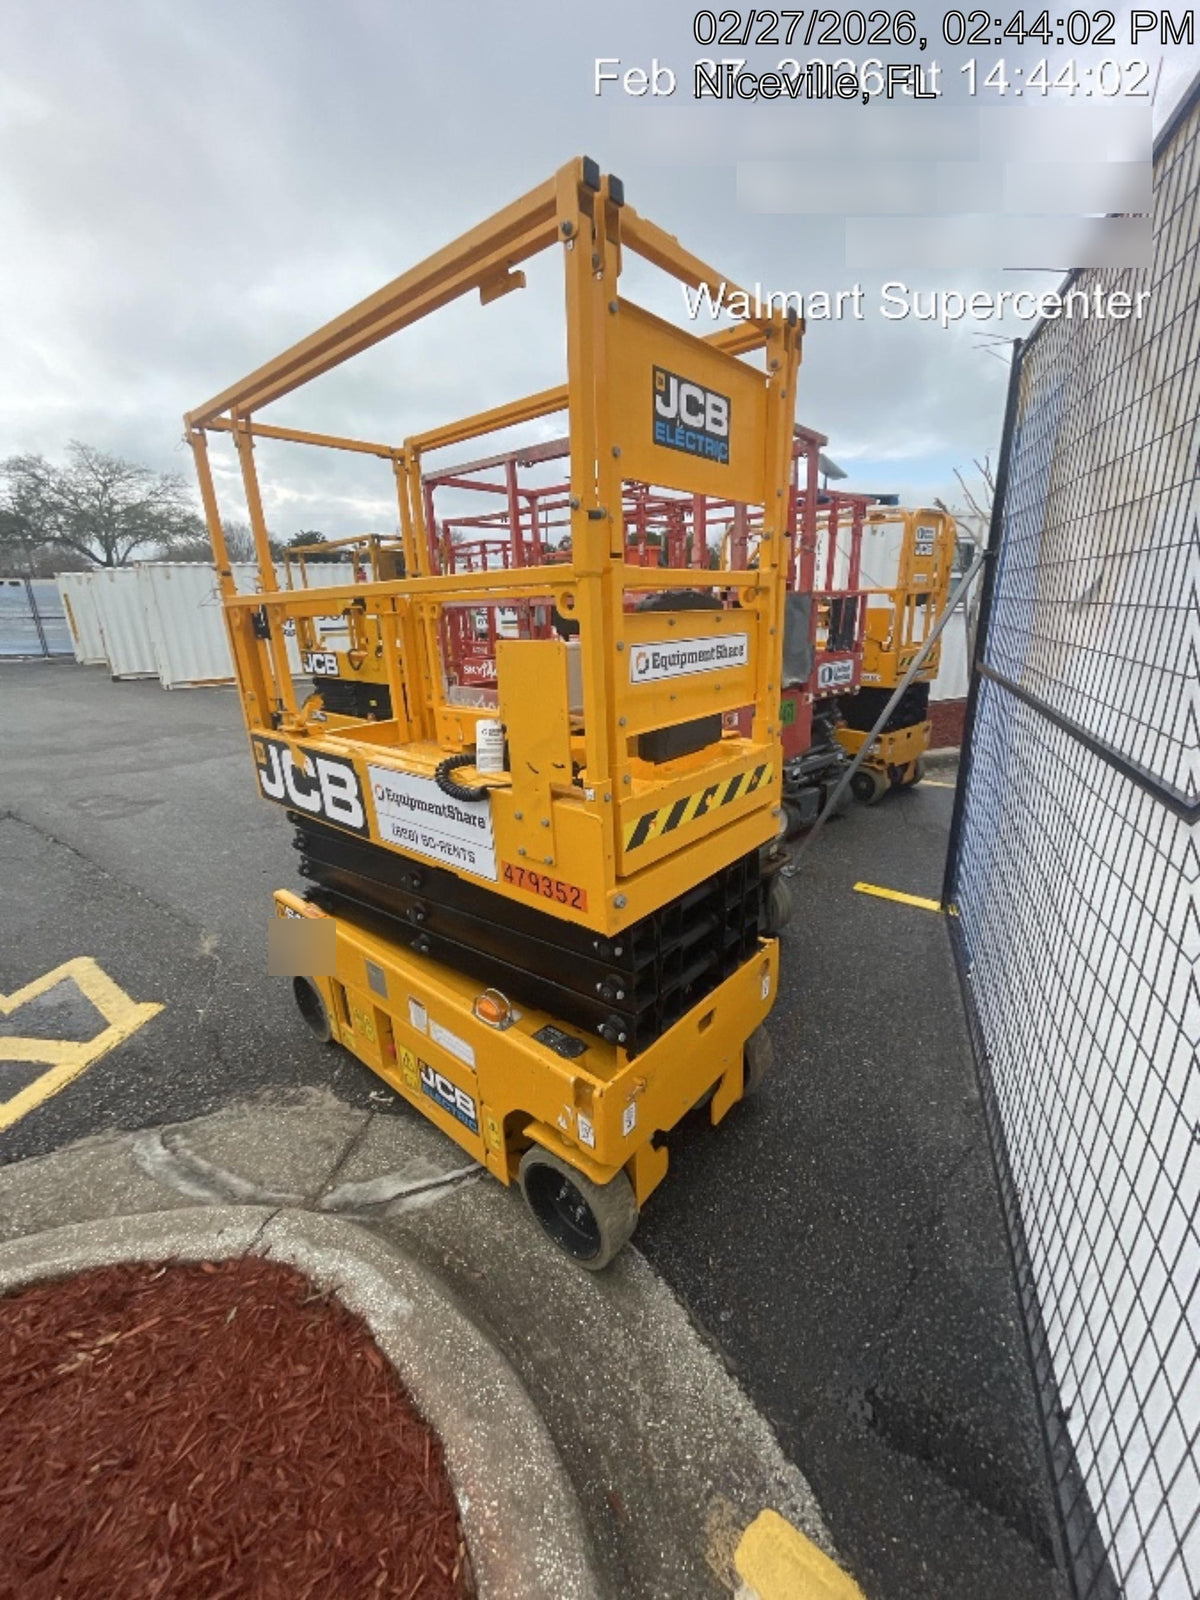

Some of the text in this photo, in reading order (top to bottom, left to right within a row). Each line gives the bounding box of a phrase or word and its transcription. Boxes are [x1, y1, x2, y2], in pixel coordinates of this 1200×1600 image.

[655, 376, 729, 437] JCB
[655, 420, 728, 460] ELECTRIC
[303, 653, 339, 675] JCB
[463, 659, 498, 679] SKYJA
[651, 644, 745, 671] EquipmentShare
[259, 744, 364, 829] JCB
[385, 787, 487, 830] EquipmentShare
[504, 864, 582, 910] 479352
[420, 1066, 476, 1120] JCB
